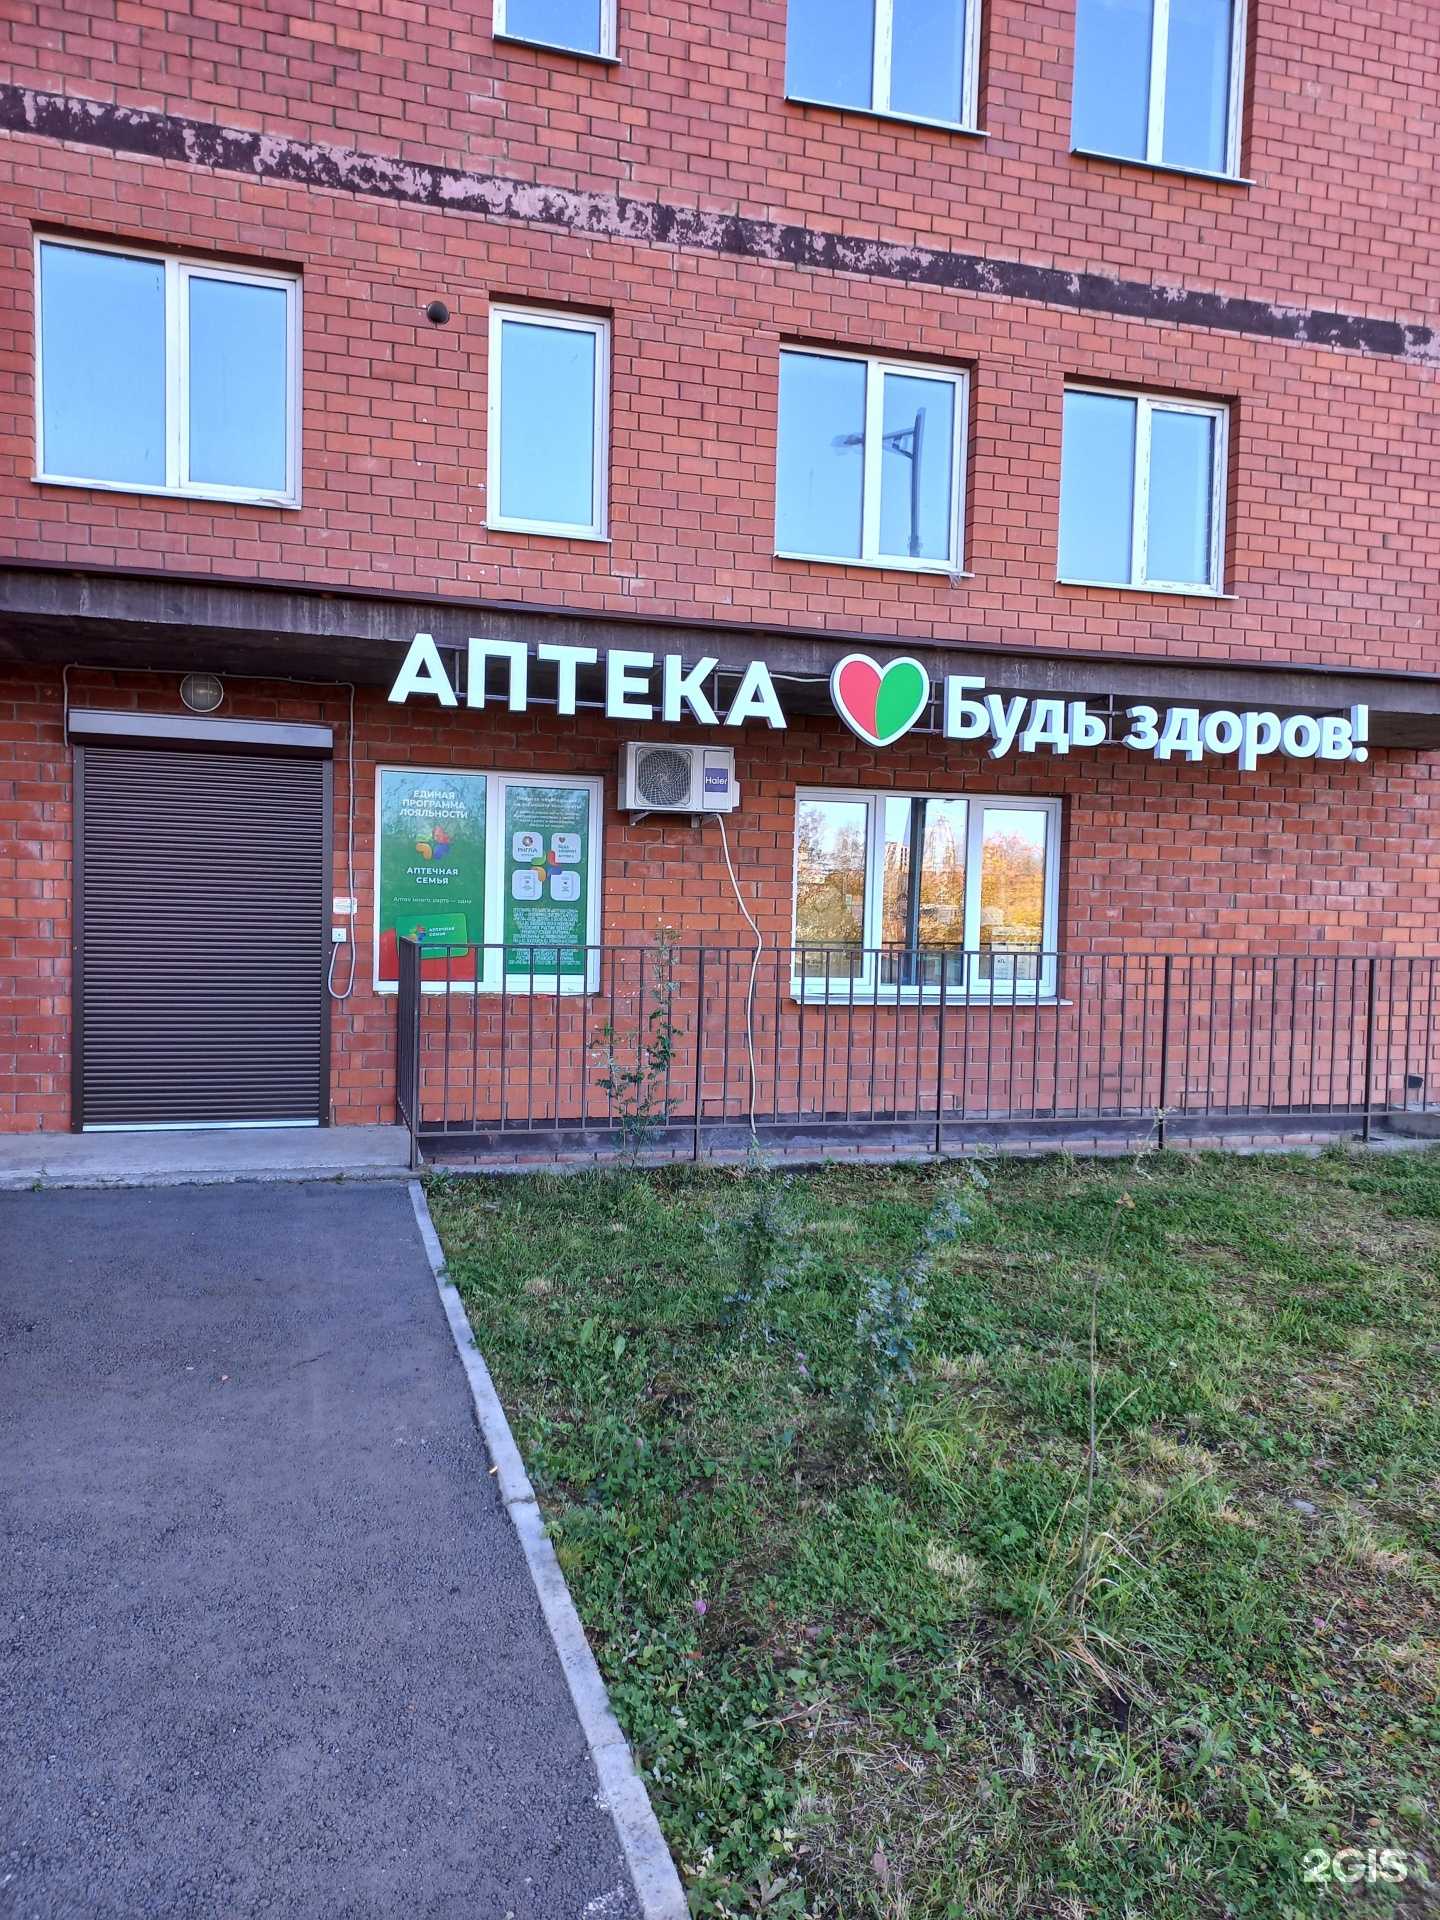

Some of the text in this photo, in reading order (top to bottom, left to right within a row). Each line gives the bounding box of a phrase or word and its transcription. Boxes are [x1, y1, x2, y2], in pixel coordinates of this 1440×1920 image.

[387, 632, 788, 730] АПТЕКА
[943, 674, 1370, 772] Будь здоров!
[705, 776, 728, 785] Haier
[413, 790, 455, 800] ЕДИНАЯ
[402, 798, 466, 809] ПРОГРАММА
[399, 808, 468, 819] ЛОЯЛЬНОСТИ
[406, 866, 459, 876] АПТЕЧНАЯ
[415, 876, 449, 884] СЕМЬЯ
